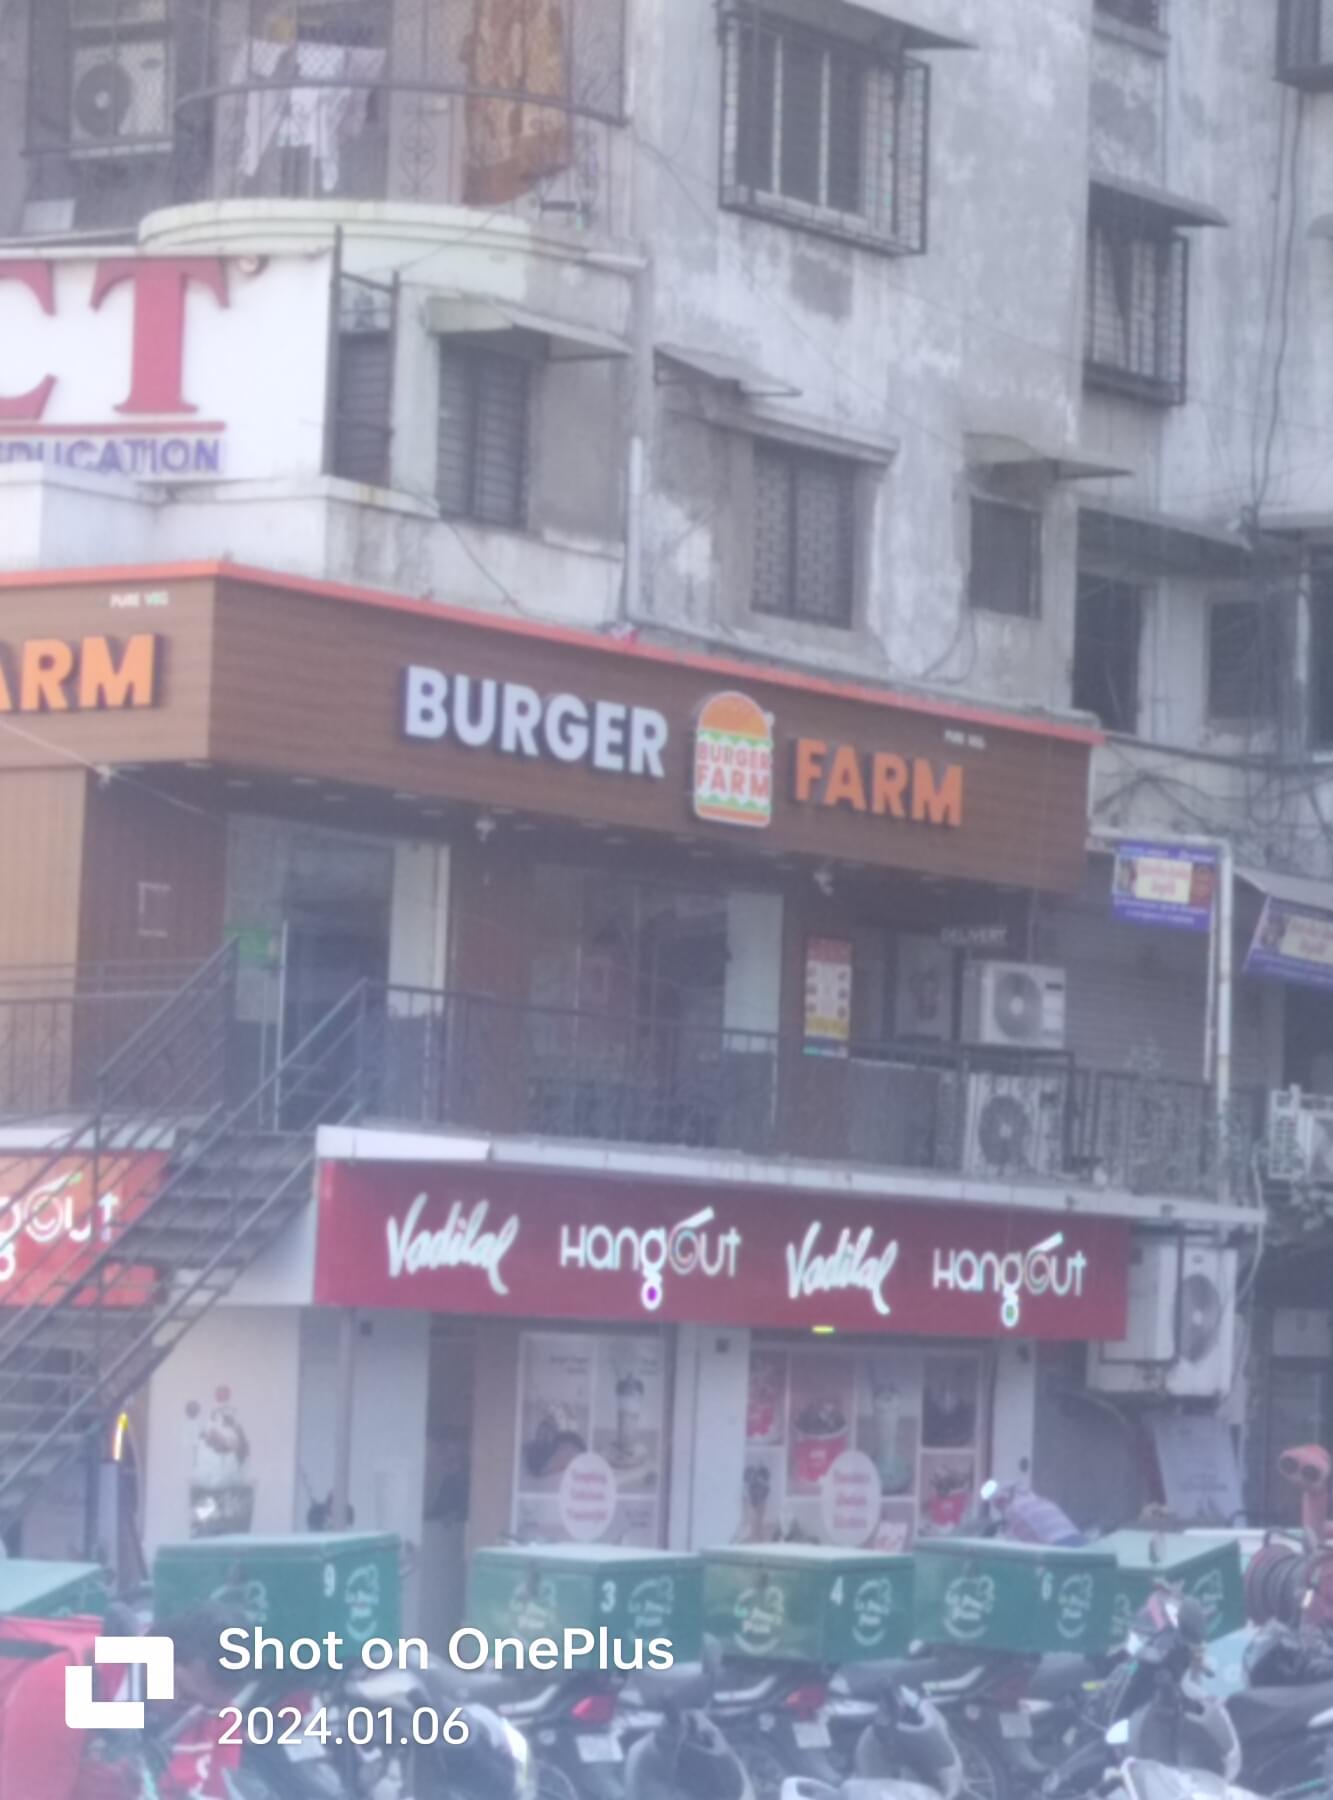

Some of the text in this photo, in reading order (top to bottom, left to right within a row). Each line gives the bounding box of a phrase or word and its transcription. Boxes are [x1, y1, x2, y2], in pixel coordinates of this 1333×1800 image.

[0, 437, 221, 475] DUCATION
[0, 633, 156, 711] RM
[404, 665, 964, 828] BURGER FARM
[700, 740, 770, 768] BURGER
[698, 763, 769, 798] FARM
[384, 1192, 521, 1296] Vadilal
[785, 1218, 900, 1316] Vadilal
[601, 1580, 617, 1613] 3
